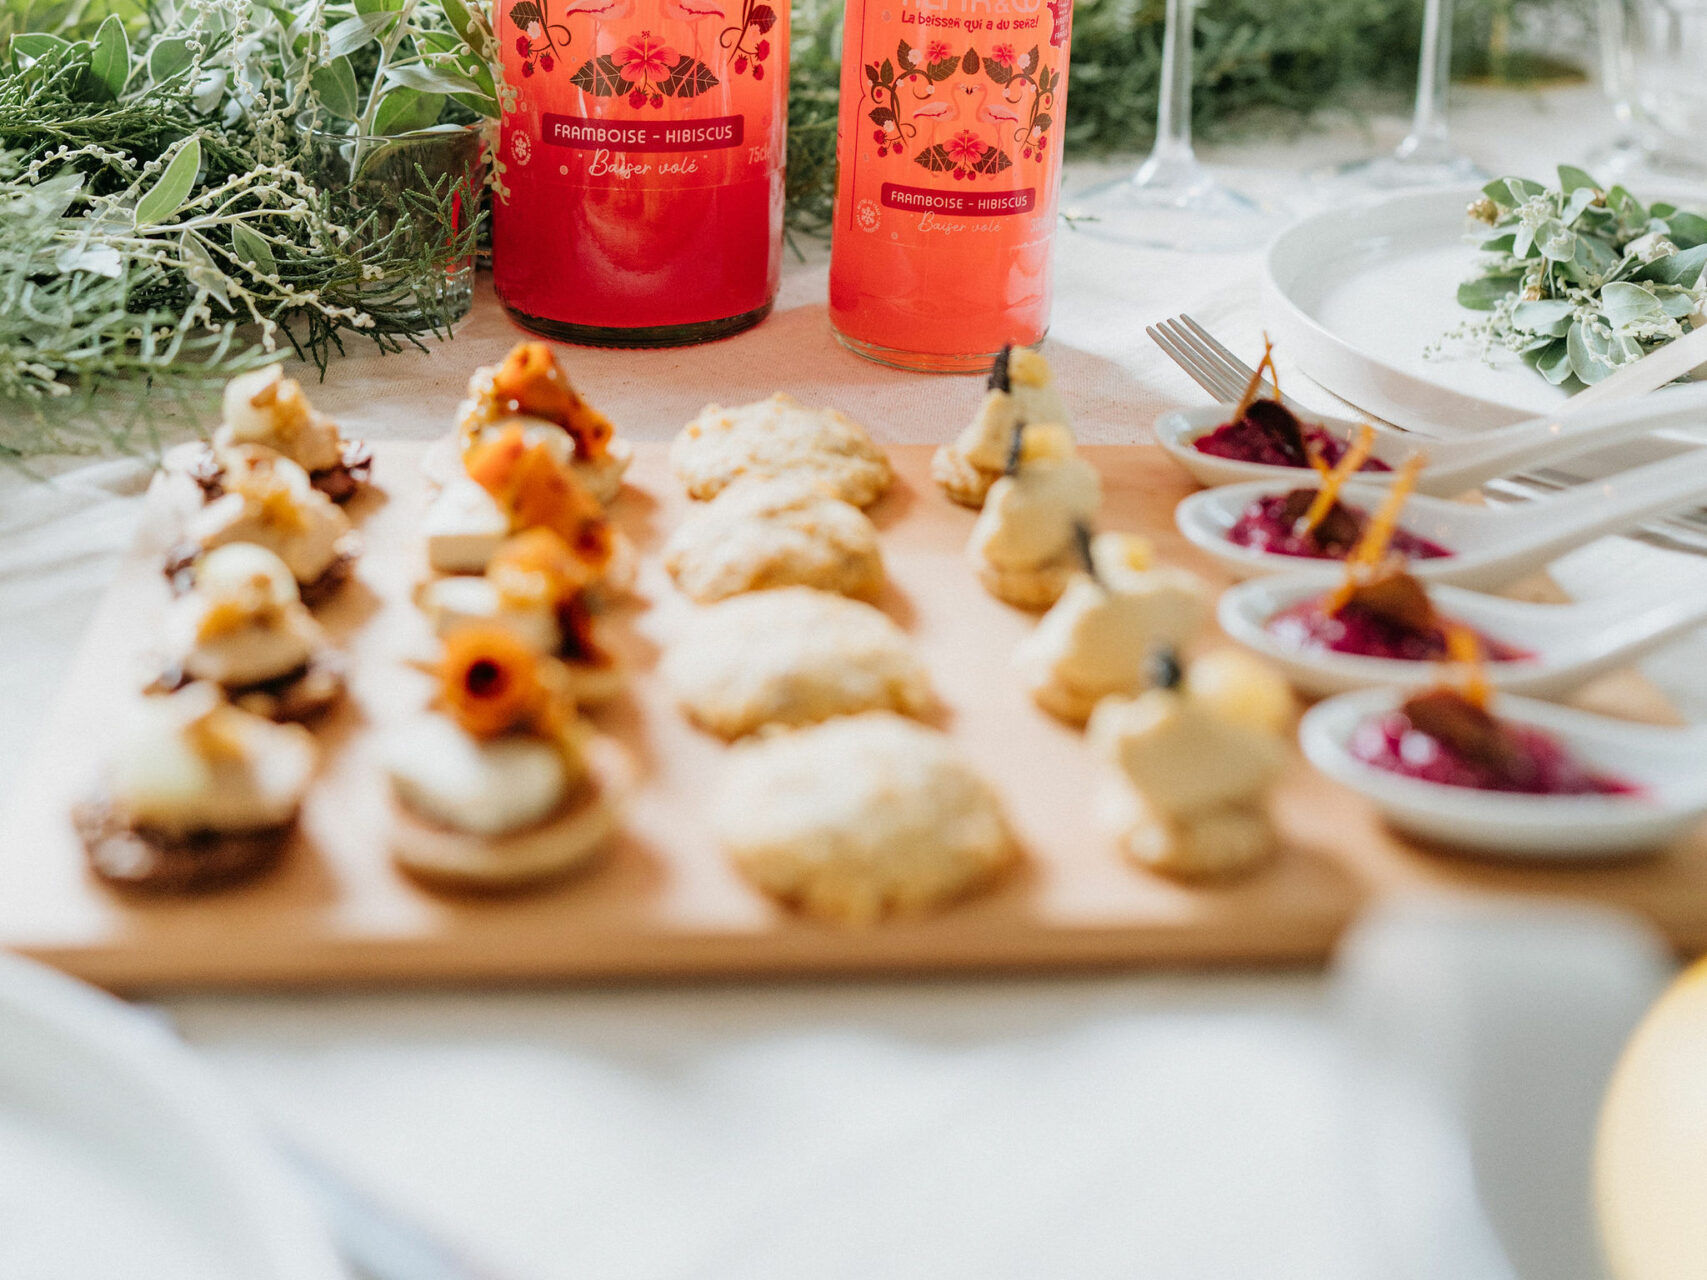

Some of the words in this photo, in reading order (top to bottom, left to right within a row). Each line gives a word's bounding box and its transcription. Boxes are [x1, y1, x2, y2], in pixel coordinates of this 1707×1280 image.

[901, 10, 916, 25] La
[918, 11, 961, 29] boisson
[963, 19, 983, 33] qui
[986, 20, 993, 30] a
[996, 19, 1010, 30] du
[554, 123, 646, 144] FRAMBOISE
[665, 125, 733, 144] HIBISCUS
[588, 148, 652, 179] Baiser
[658, 156, 699, 175] volé
[891, 190, 964, 210] FRAMBOISE
[977, 195, 1028, 210] HIBISCUS
[917, 210, 966, 235] Baiser
[971, 221, 1002, 233] volé
